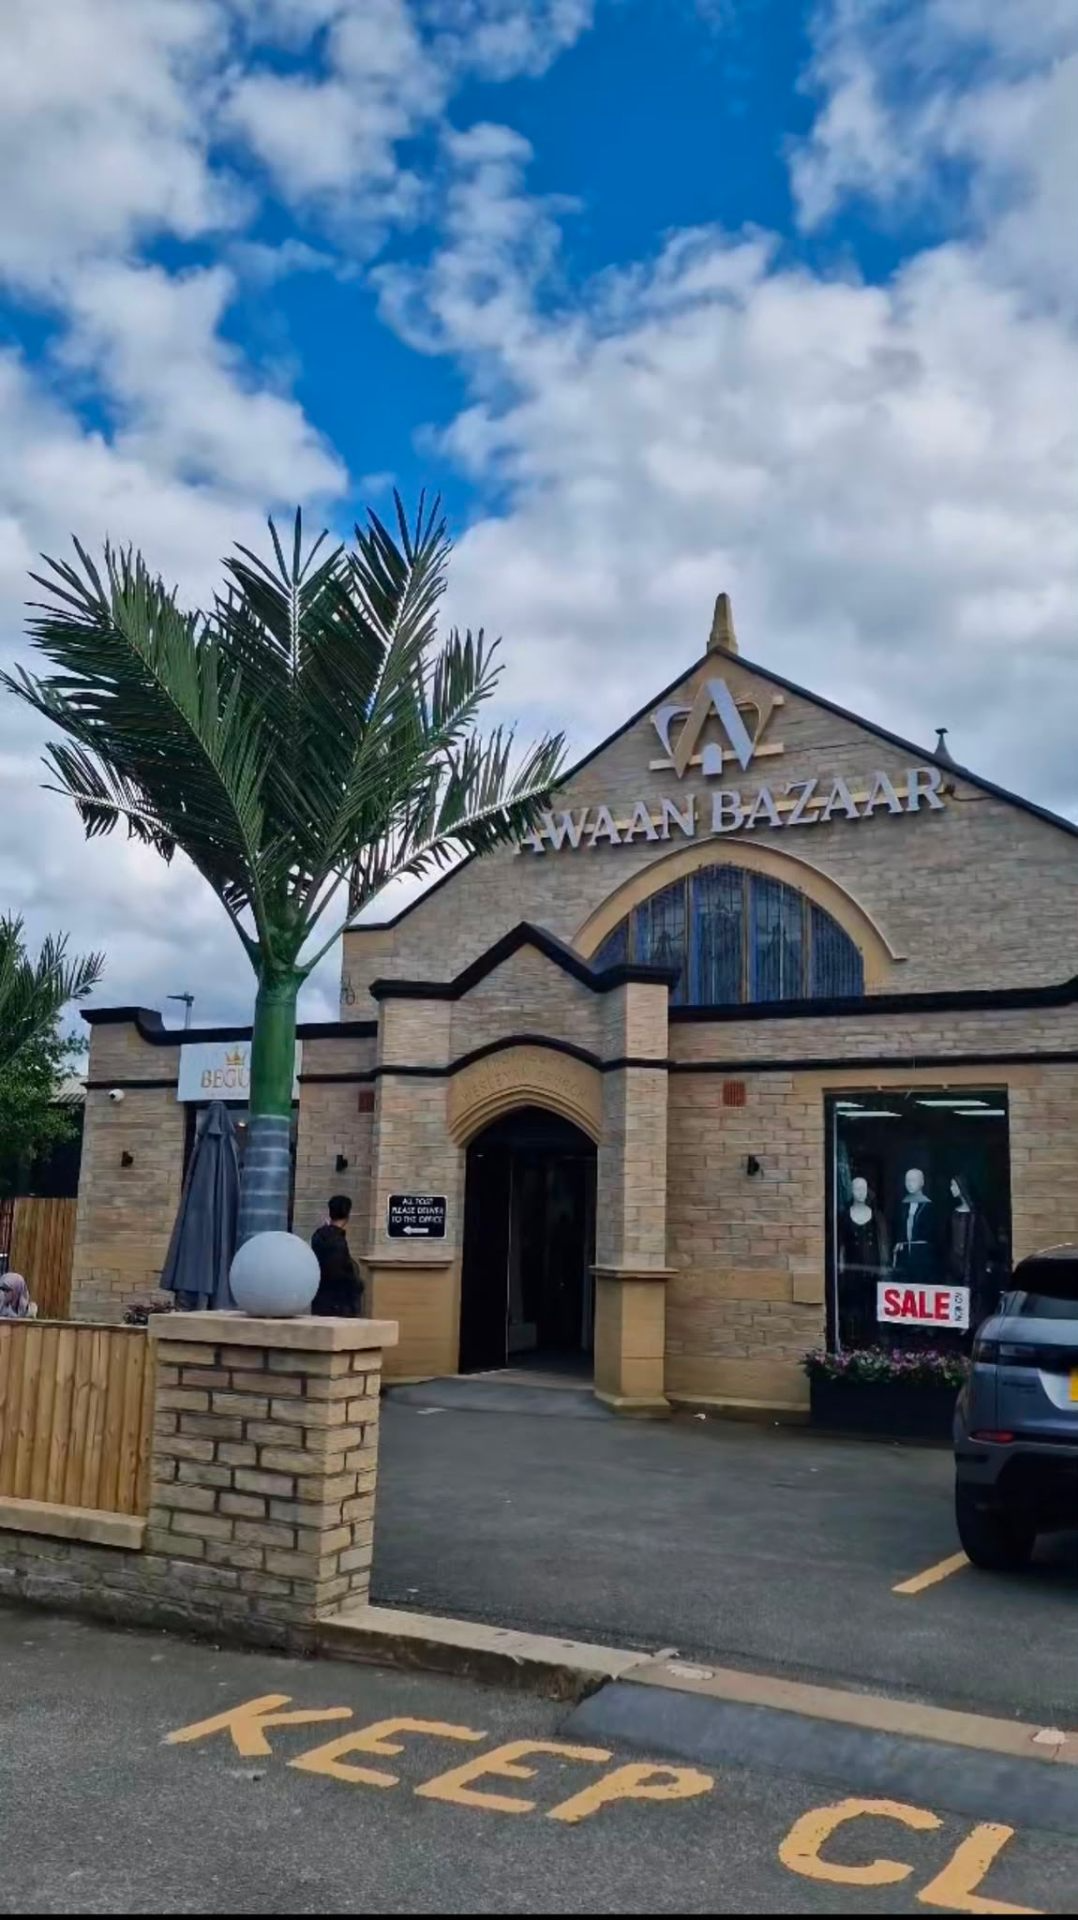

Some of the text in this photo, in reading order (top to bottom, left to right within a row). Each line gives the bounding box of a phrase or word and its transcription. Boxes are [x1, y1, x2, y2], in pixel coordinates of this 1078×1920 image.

[513, 766, 945, 855] AWAAN BAZAAR
[200, 1068, 249, 1089] BEGU
[391, 1206, 415, 1214] PLEASE
[403, 1215, 416, 1223] THE
[884, 1288, 951, 1321] SALE
[164, 1693, 716, 1823] KEEP
